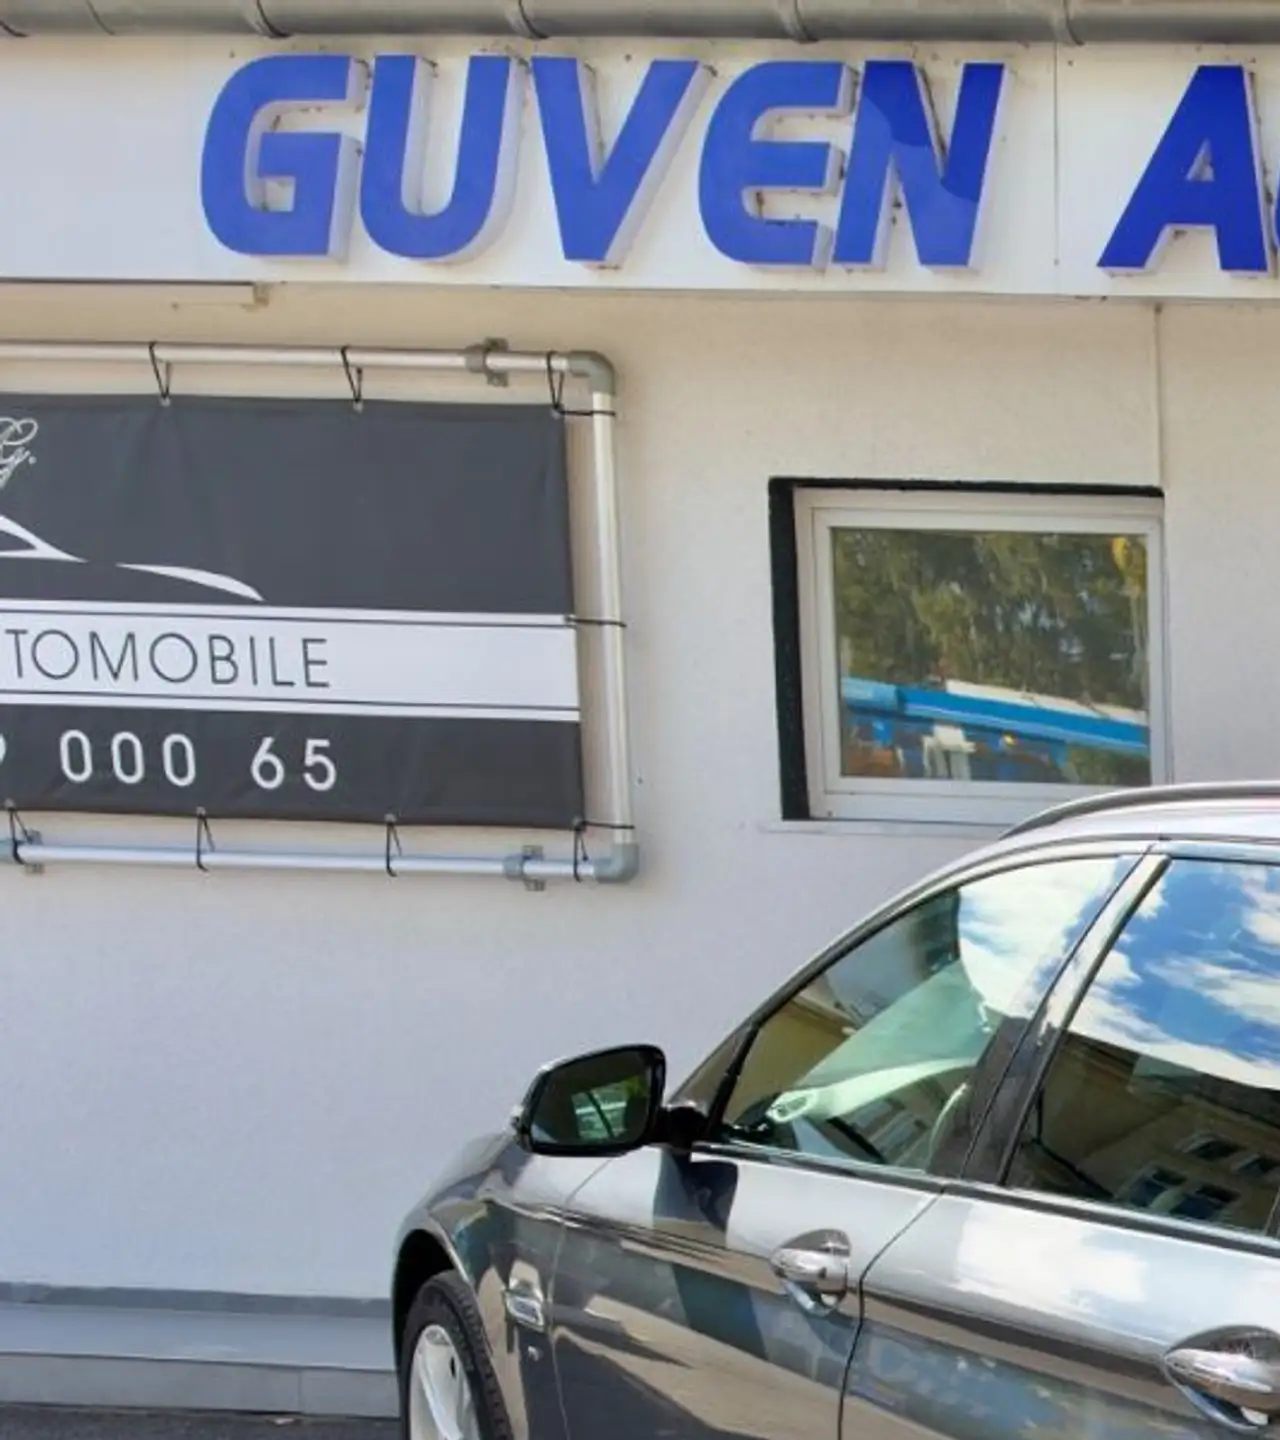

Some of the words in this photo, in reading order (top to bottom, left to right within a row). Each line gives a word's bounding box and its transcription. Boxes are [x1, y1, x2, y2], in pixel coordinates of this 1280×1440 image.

[200, 54, 1006, 268] GUVEN
[60, 729, 196, 787] 000
[250, 736, 337, 791] 65
